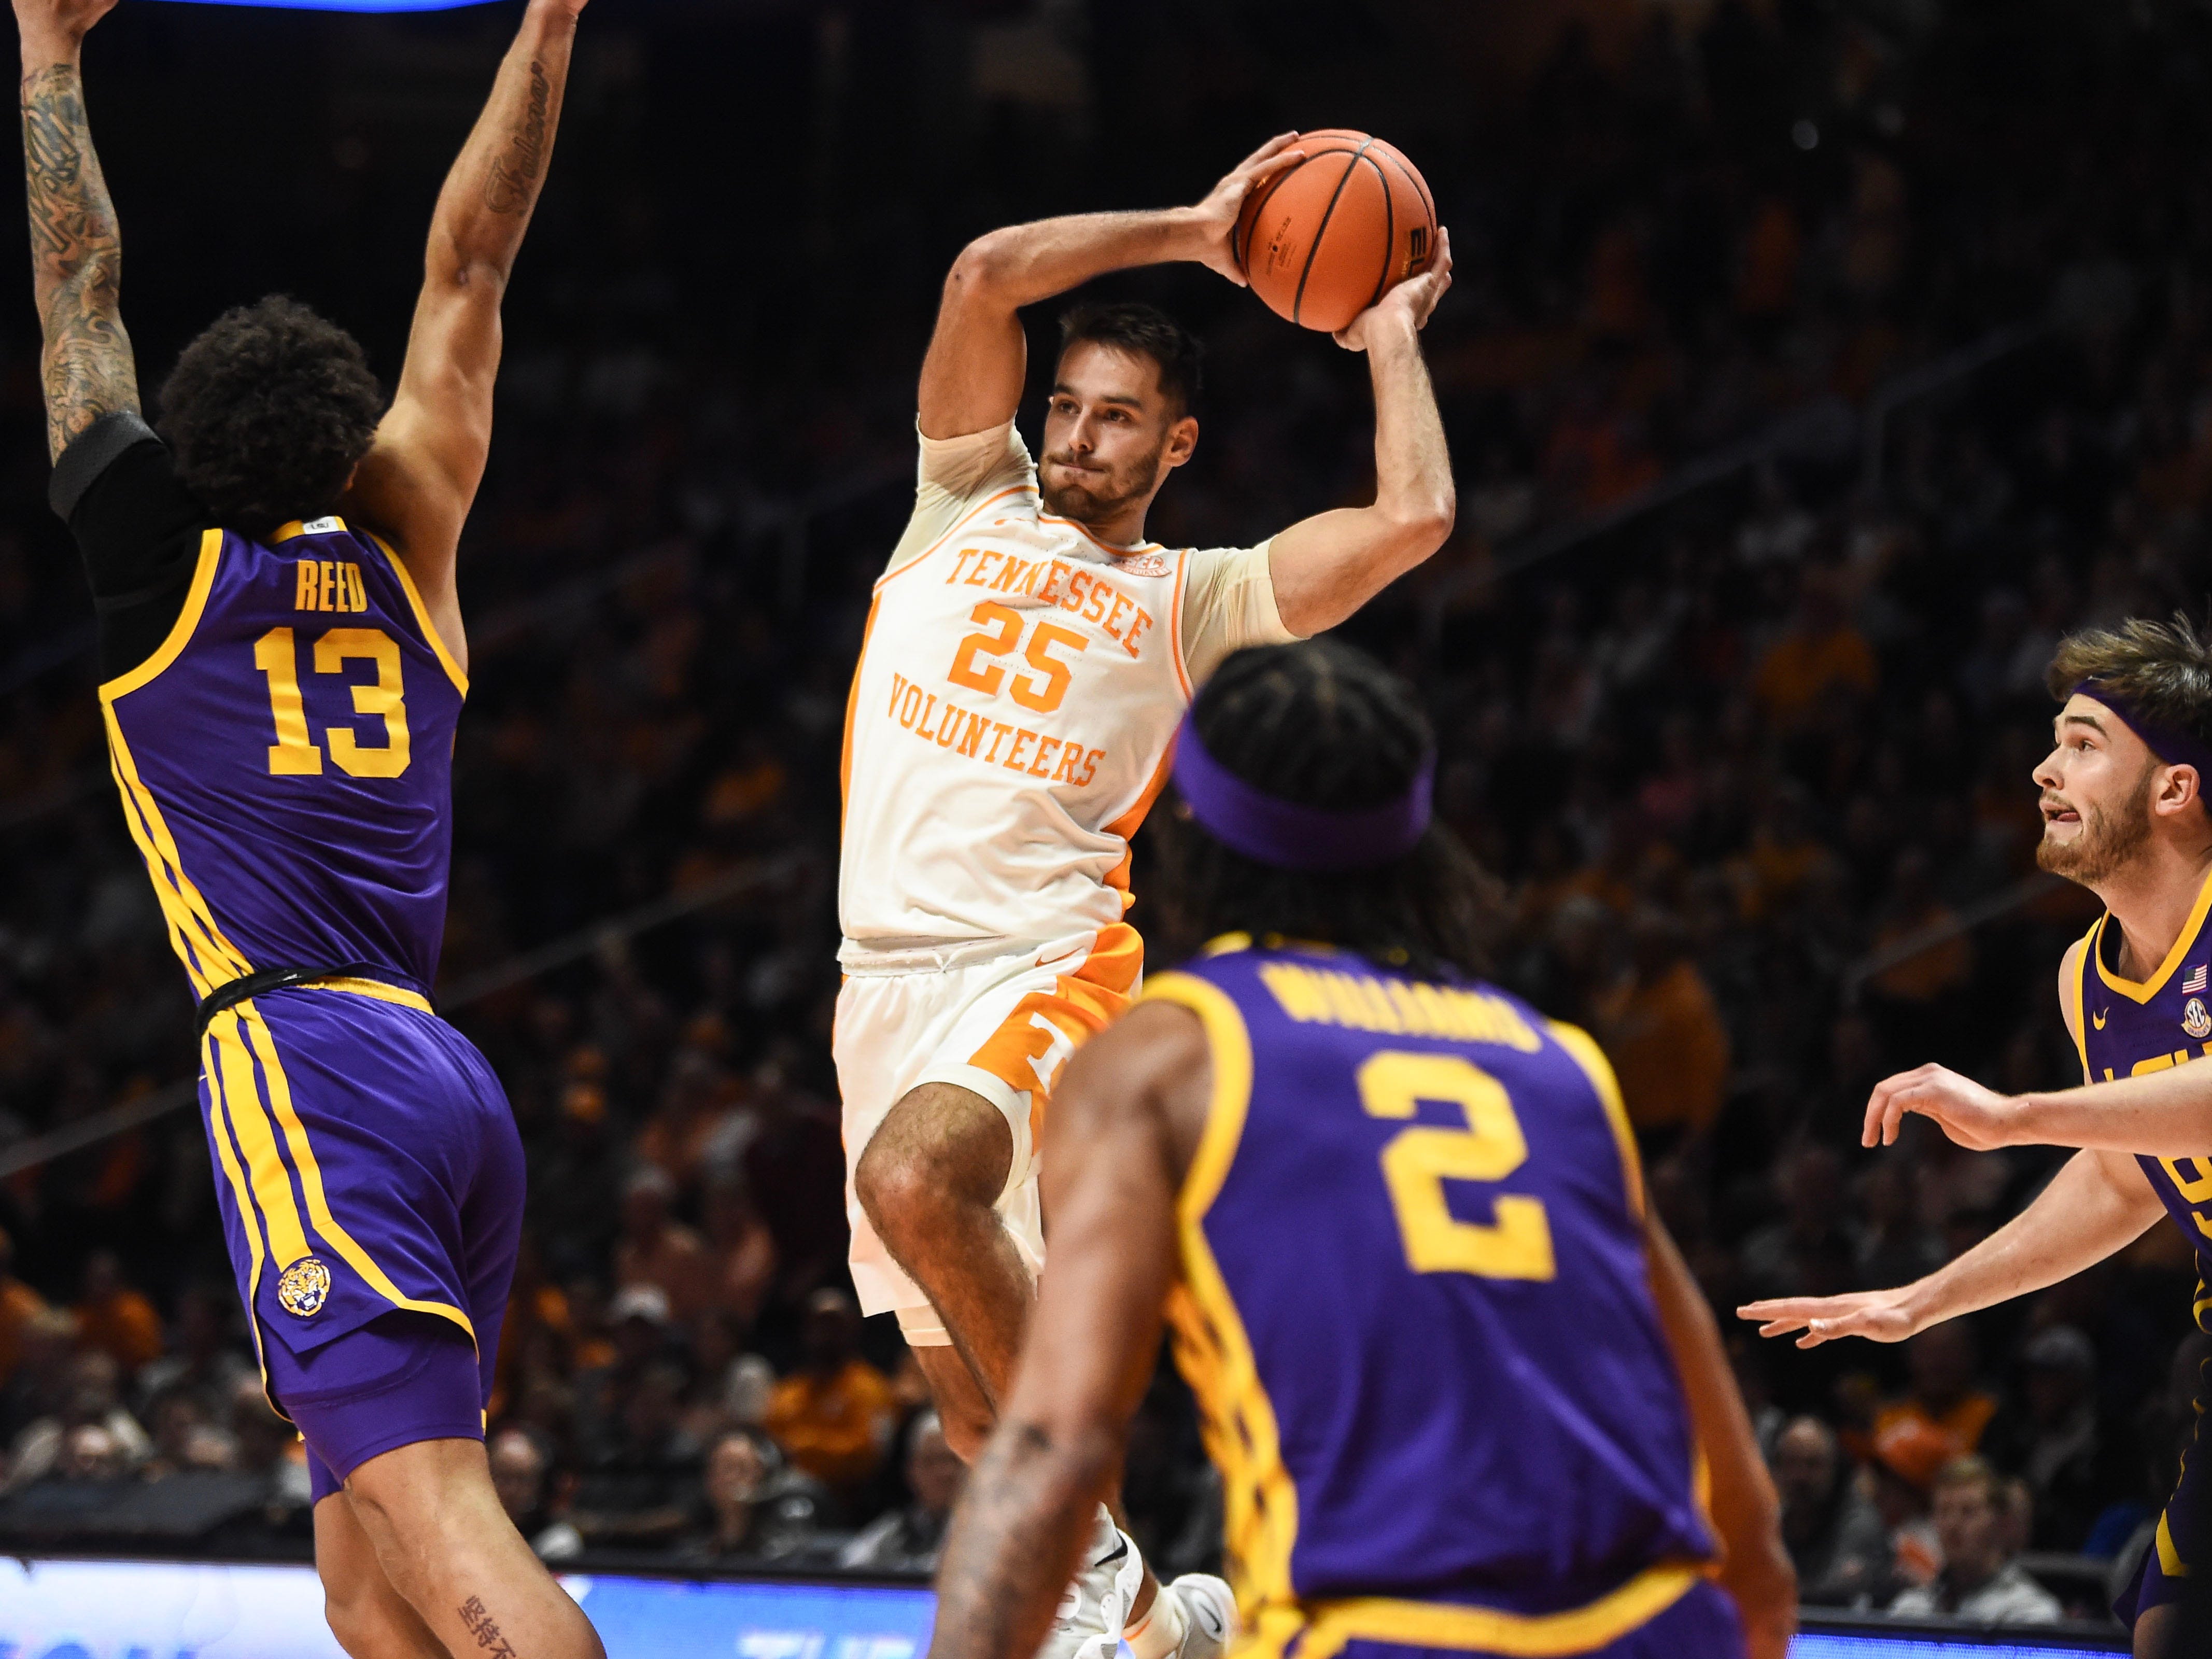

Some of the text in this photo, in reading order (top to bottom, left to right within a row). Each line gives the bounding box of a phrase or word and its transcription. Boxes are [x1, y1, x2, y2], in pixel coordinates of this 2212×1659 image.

[294, 559, 368, 613] REED
[946, 548, 1153, 659] TENNESSEE
[253, 626, 412, 778] 13
[947, 600, 1090, 714] 25
[887, 672, 1107, 788] VOLUNTEERS
[2186, 1001, 2205, 1028] SEC
[1356, 1047, 1556, 1283] 2
